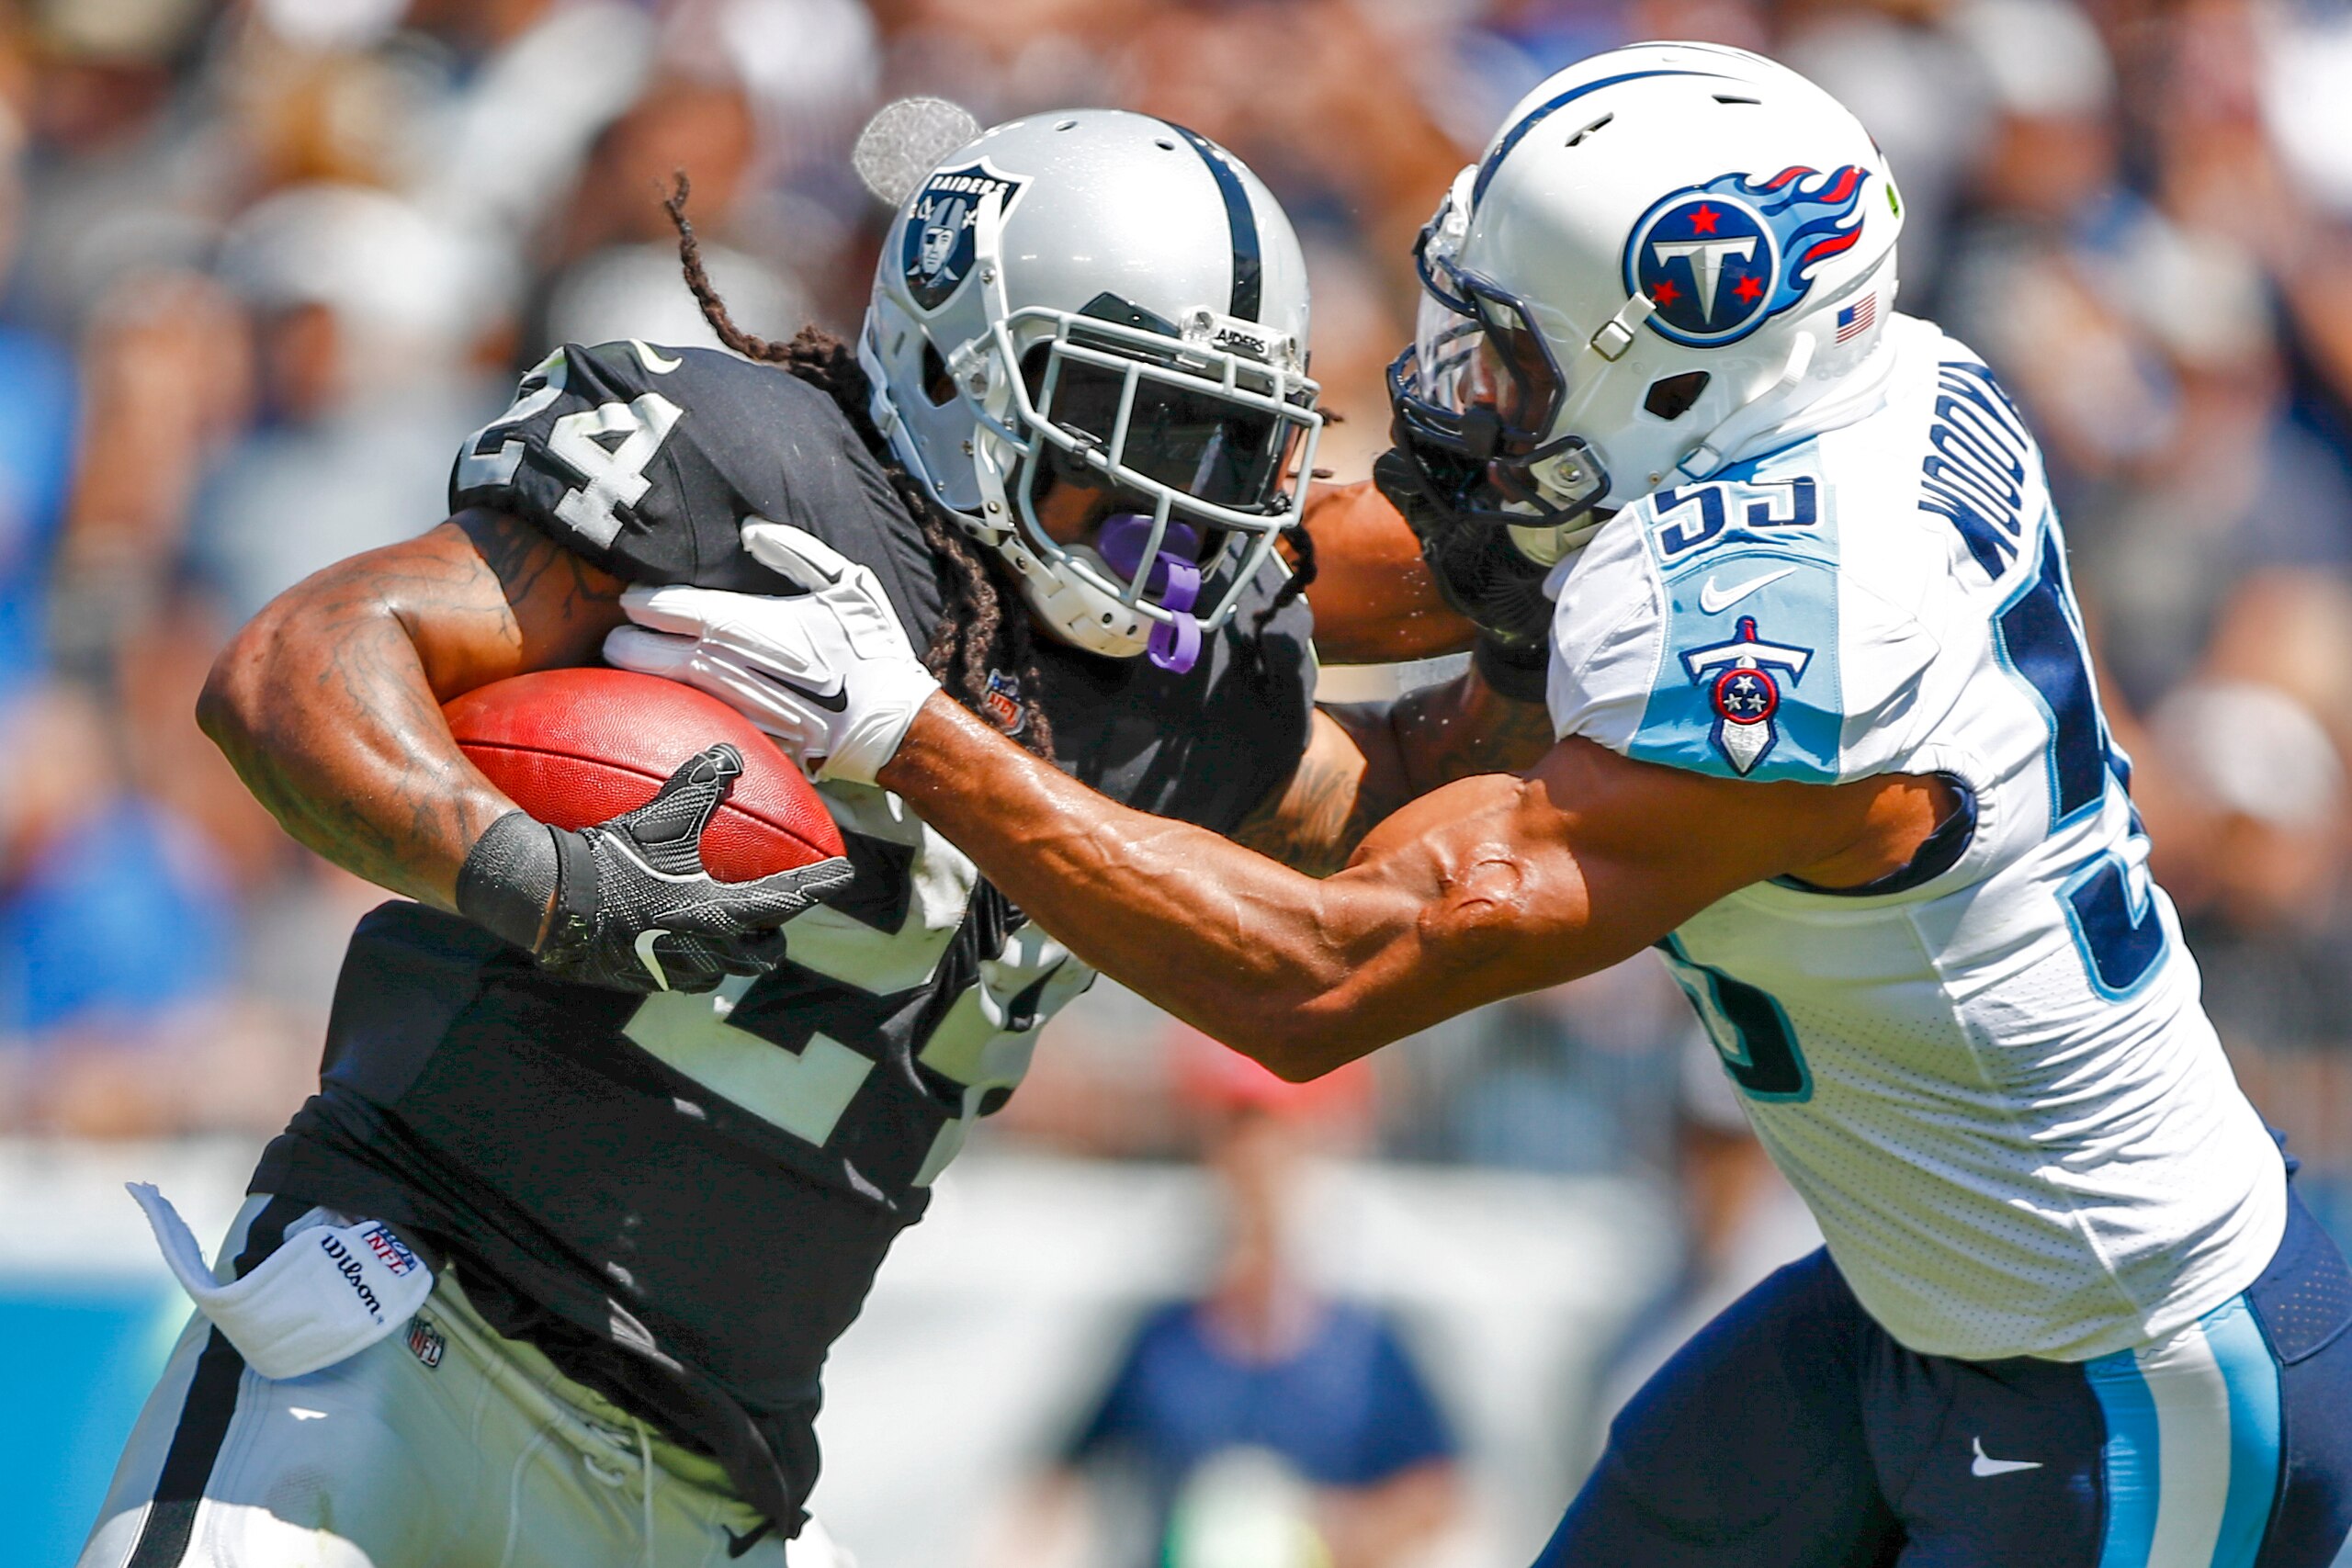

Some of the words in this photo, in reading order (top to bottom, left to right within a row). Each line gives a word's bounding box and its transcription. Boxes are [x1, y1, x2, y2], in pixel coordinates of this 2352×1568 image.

[457, 345, 684, 551] 24
[321, 1233, 382, 1315] Wilson
[367, 1235, 405, 1275] NFL
[411, 1329, 436, 1364] NFL
